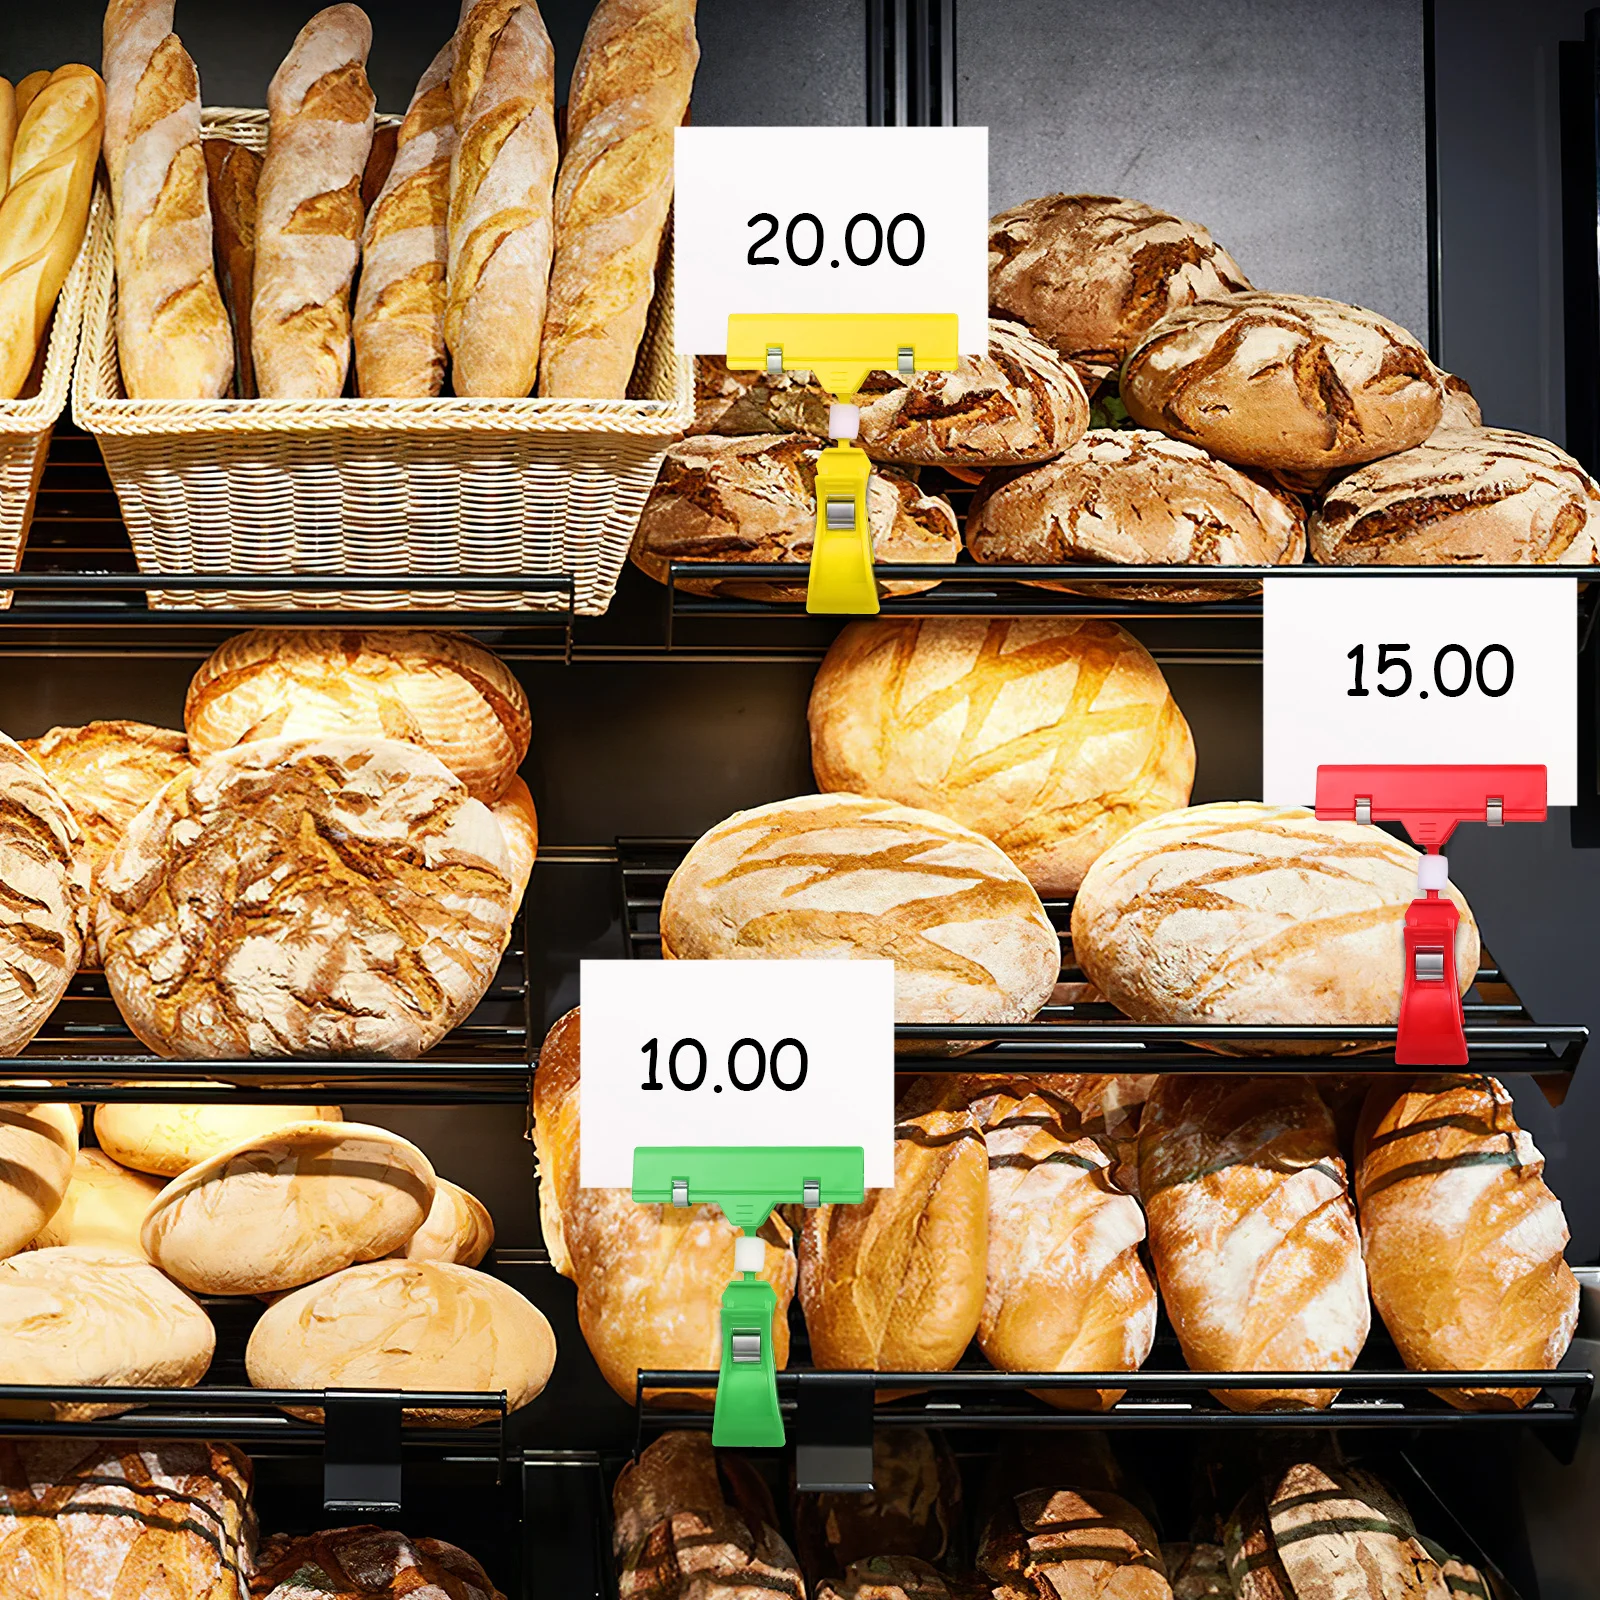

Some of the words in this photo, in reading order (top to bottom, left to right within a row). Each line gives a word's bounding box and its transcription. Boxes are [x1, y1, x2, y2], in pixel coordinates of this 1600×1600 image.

[748, 213, 925, 268] 20.00
[1348, 644, 1514, 699] 15.00
[642, 1038, 808, 1093] 10.00
